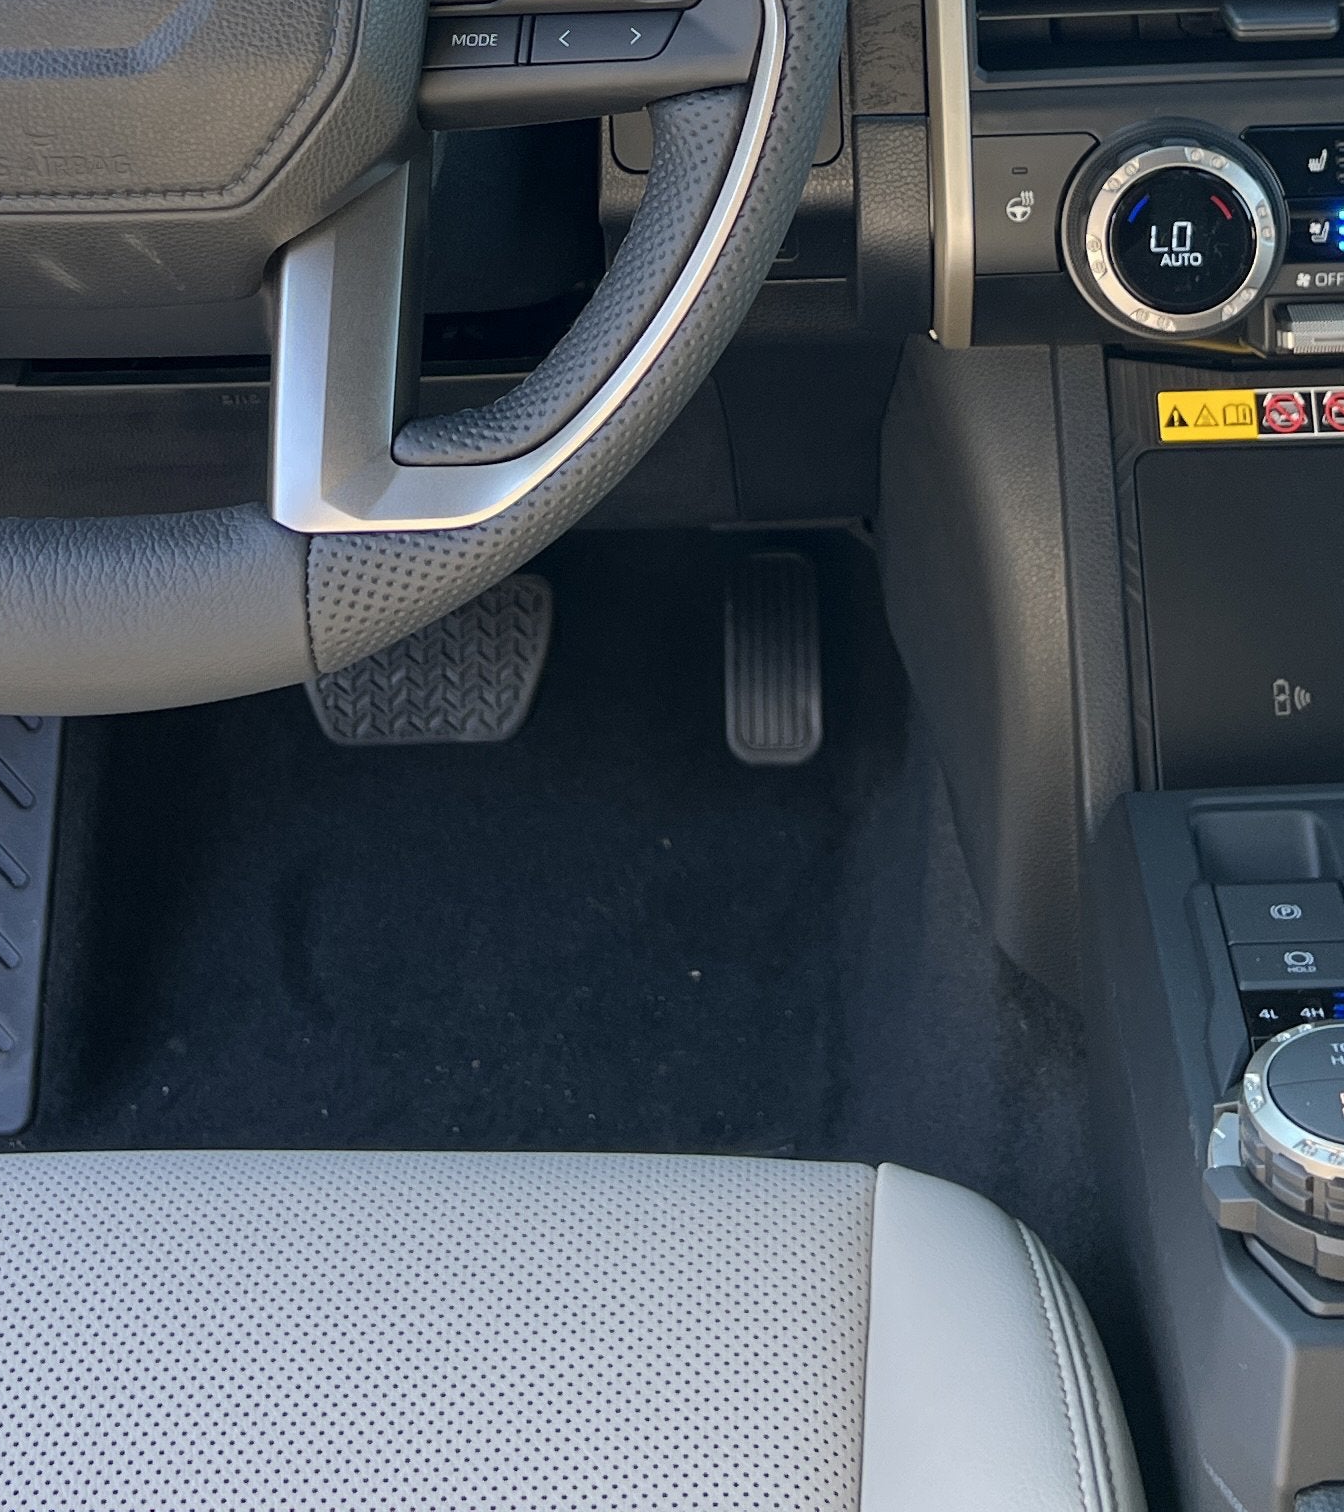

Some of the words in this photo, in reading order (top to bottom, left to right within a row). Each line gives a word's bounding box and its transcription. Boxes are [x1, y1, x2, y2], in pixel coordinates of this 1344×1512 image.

[451, 33, 499, 48] MODE
[1159, 252, 1203, 268] AUTO
[1286, 965, 1317, 974] HOLD
[1258, 1007, 1279, 1020] 4L
[1299, 1007, 1325, 1019] 4H
